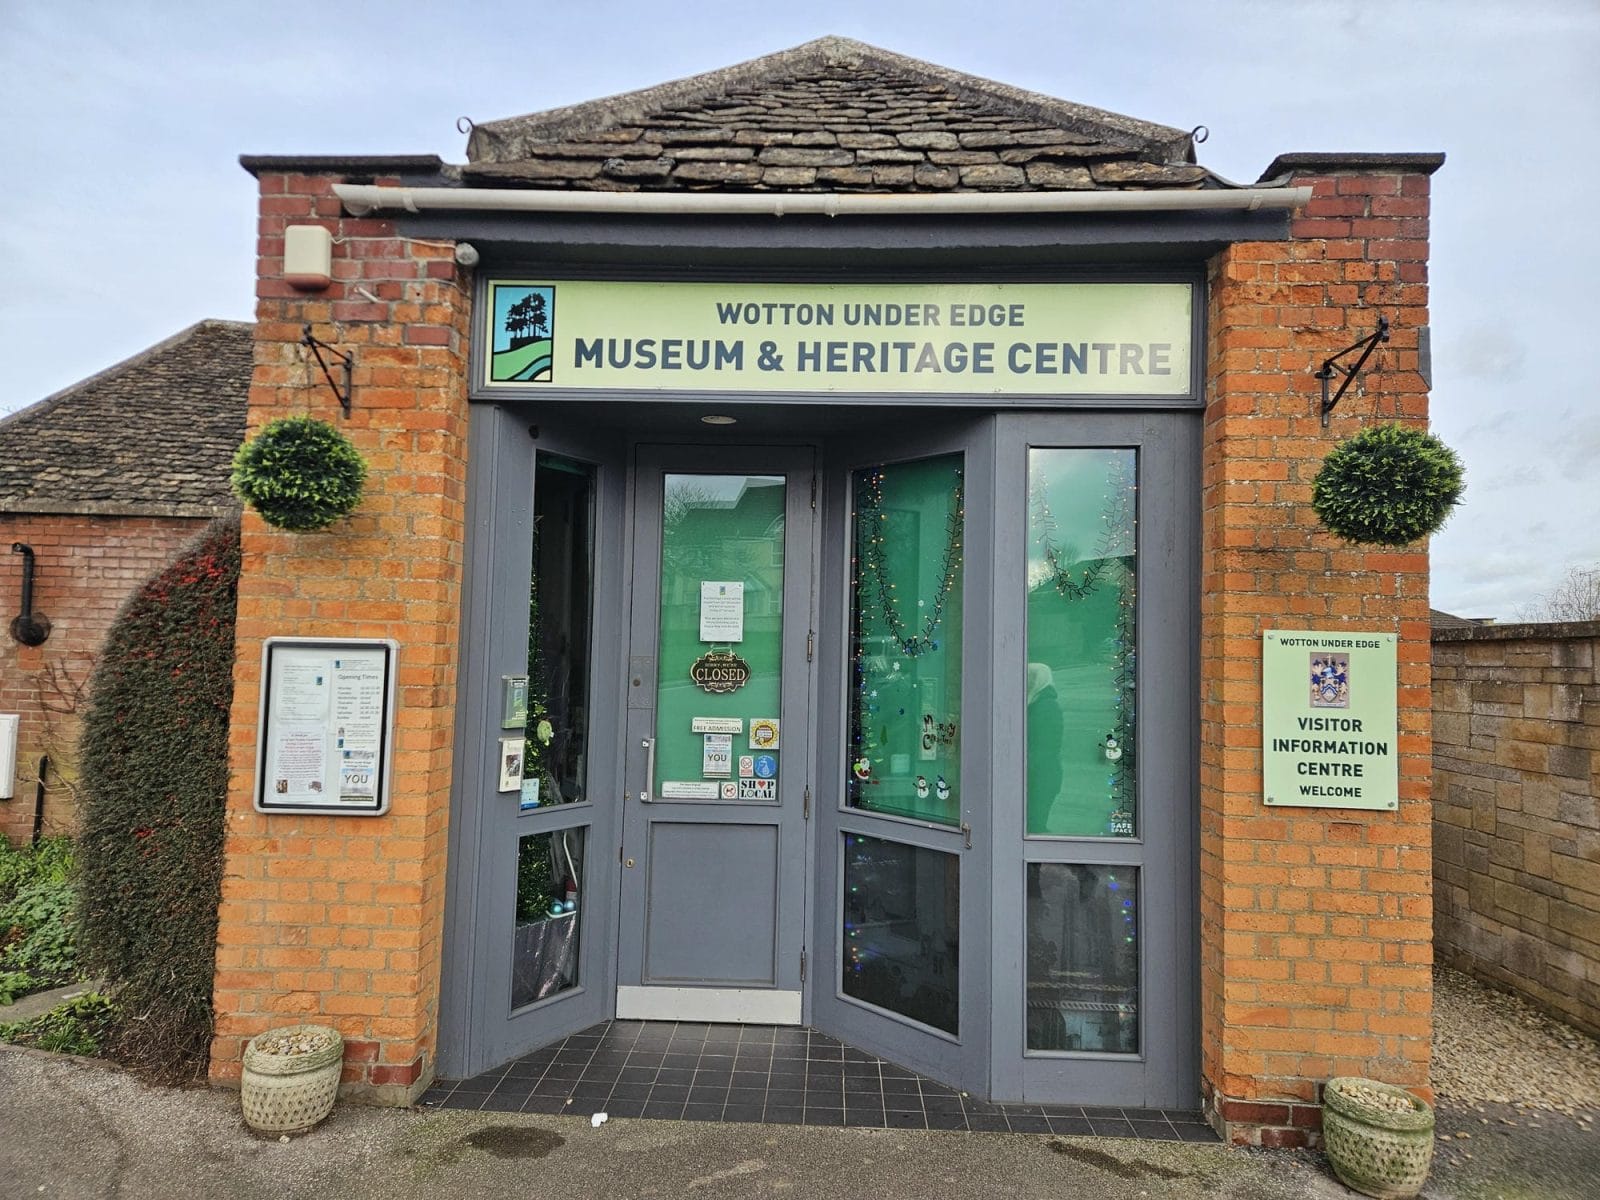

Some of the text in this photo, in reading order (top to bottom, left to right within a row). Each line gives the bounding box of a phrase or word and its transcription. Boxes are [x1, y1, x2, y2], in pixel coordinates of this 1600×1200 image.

[715, 303, 1024, 326] WOTTON UNDER EDGE
[574, 338, 1170, 374] MUSEUM & HERITAGE CENTRE
[1280, 638, 1380, 649] WOTTON UNDER EDGE
[696, 668, 746, 681] CLOSED
[1298, 717, 1363, 733] VISITOR
[1273, 739, 1387, 756] INFORMATION
[708, 754, 727, 762] YOU
[1297, 762, 1364, 778] CENTRE
[344, 774, 369, 784] YOU
[1299, 786, 1362, 798] WELCOME
